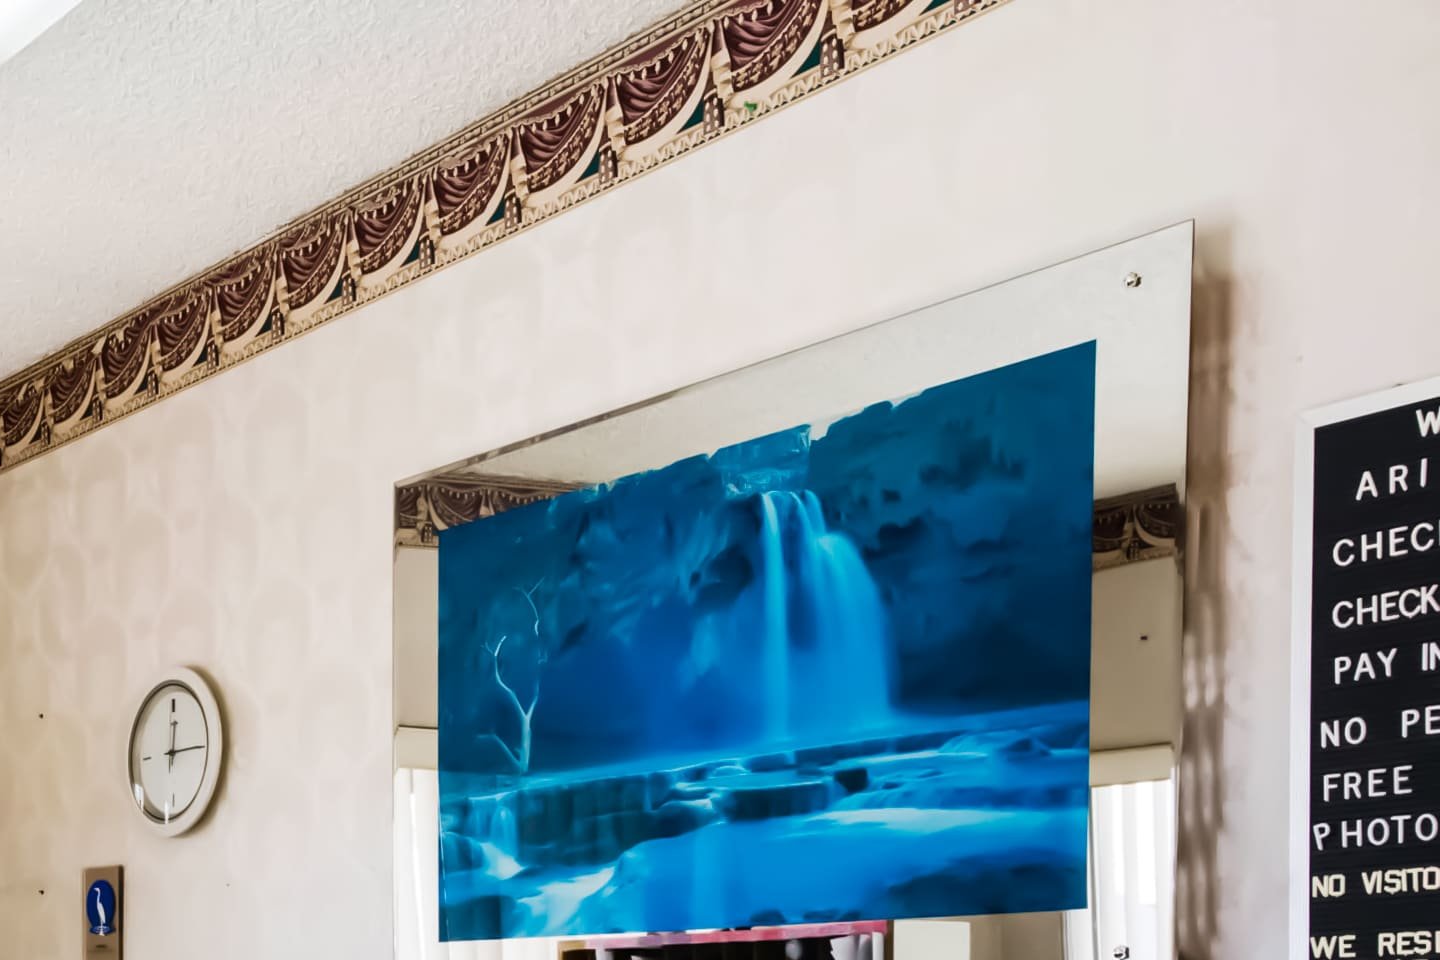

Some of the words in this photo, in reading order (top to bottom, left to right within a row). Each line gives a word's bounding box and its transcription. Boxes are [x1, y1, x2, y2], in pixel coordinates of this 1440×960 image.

[1332, 520, 1440, 567] CHEC
[1332, 584, 1440, 628] CHECK
[1334, 648, 1397, 684] PAY
[1320, 717, 1367, 748] NO
[1322, 765, 1412, 802] FREE
[1312, 813, 1439, 851] PHOTO
[1312, 873, 1346, 898] NO
[1361, 866, 1440, 895] VISITO
[1310, 934, 1357, 960] WE
